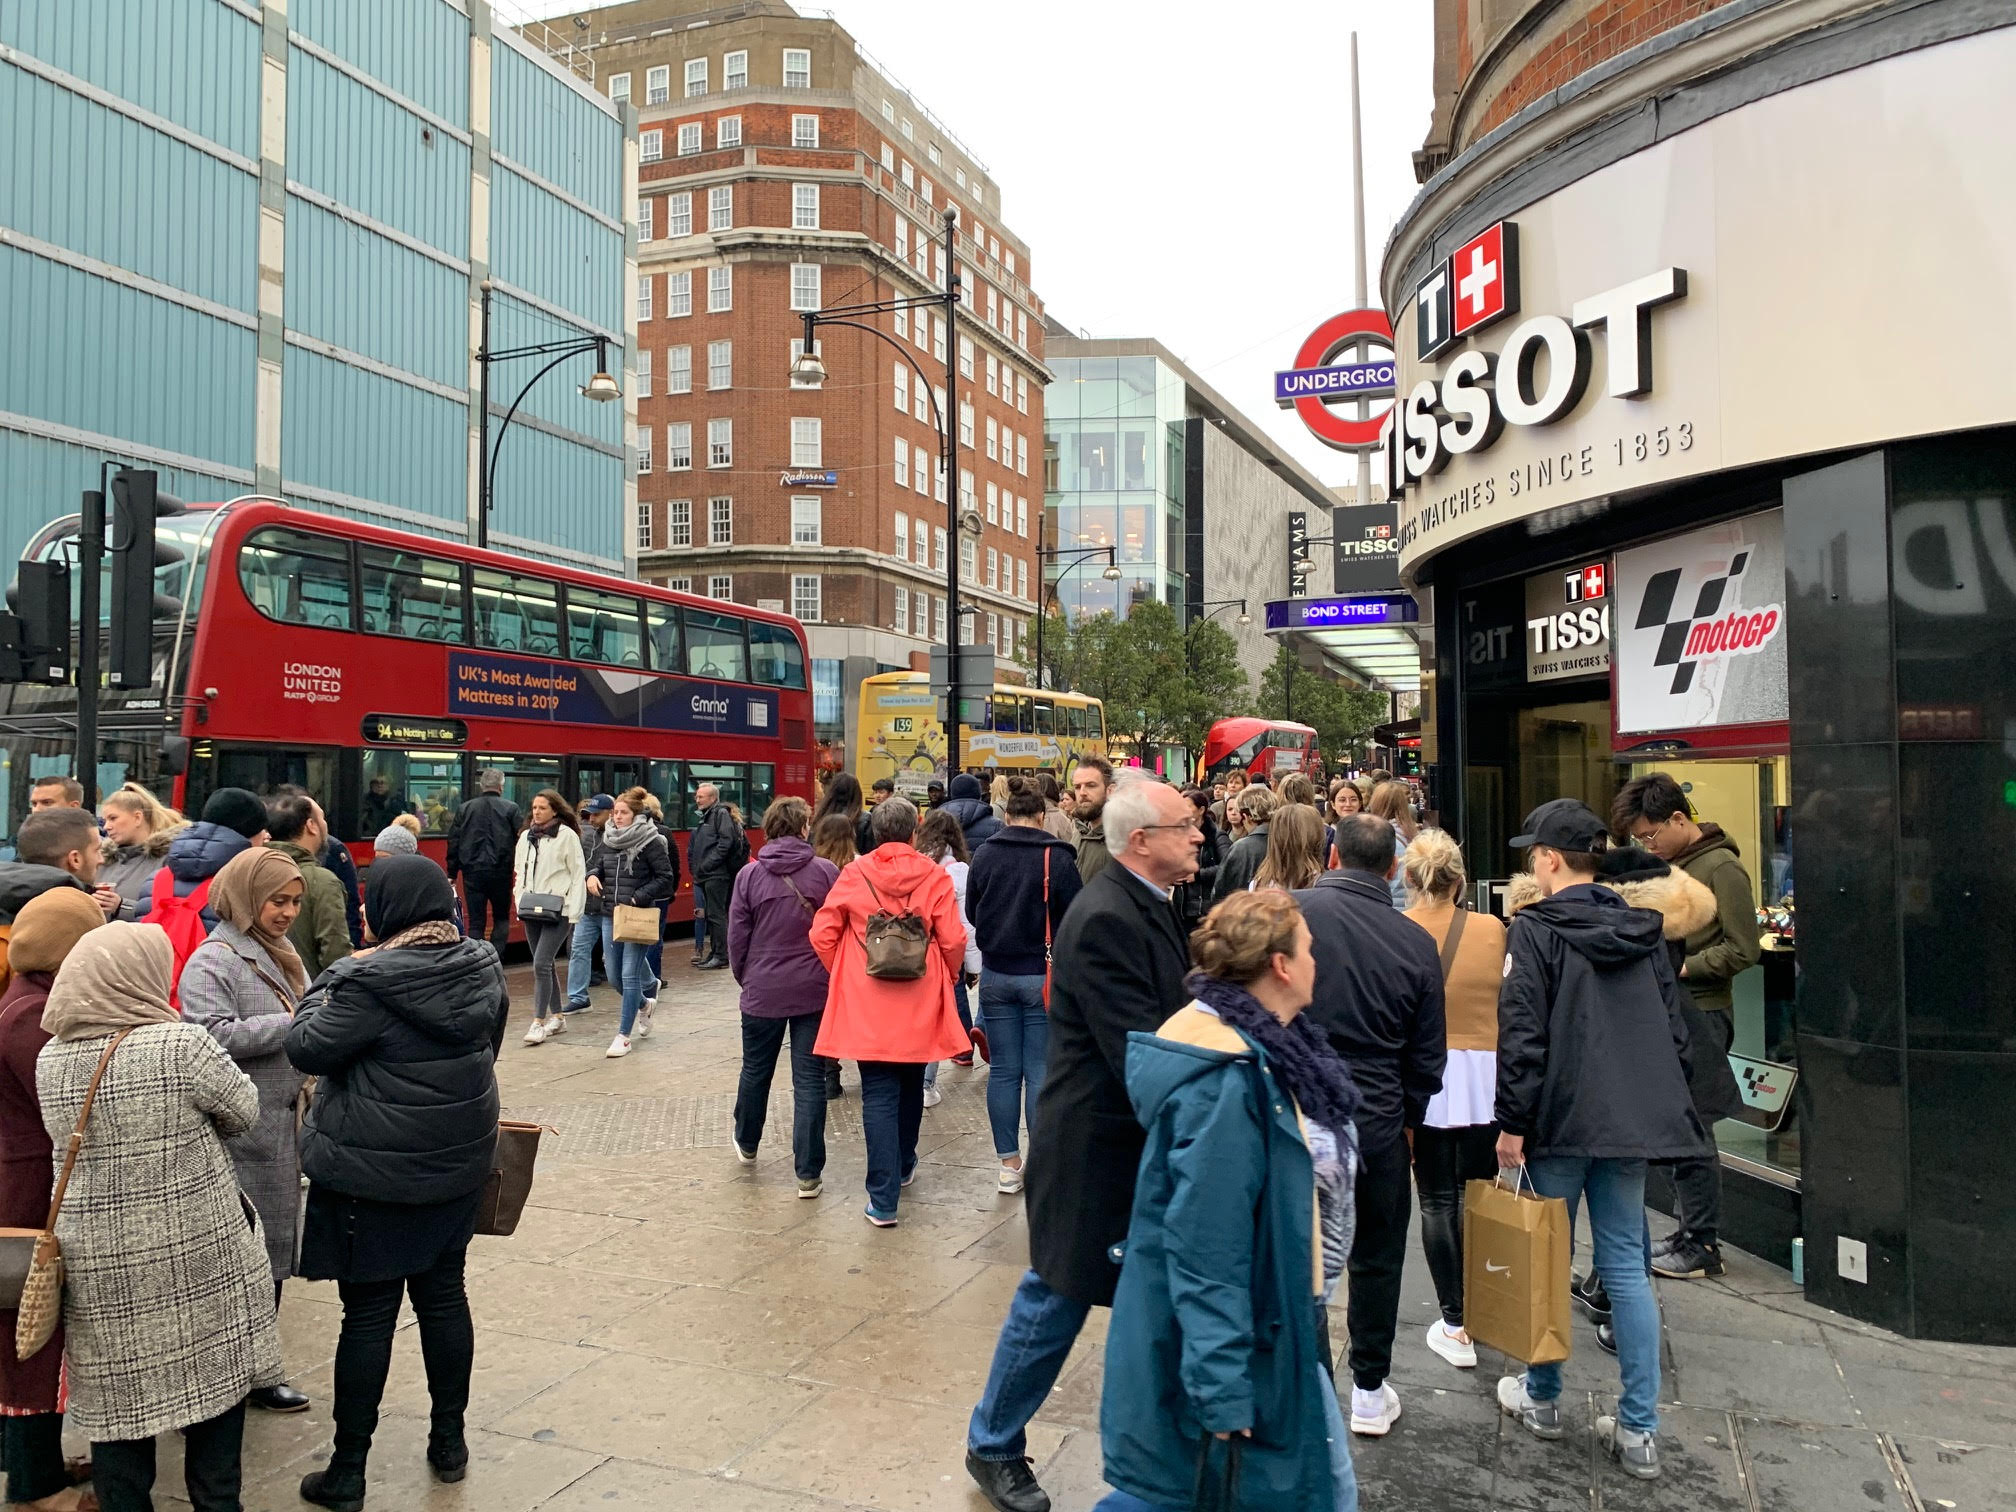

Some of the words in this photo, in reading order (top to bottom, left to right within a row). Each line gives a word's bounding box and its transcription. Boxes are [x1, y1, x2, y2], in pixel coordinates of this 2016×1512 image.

[1284, 366, 1396, 392] UNDERGRO
[1379, 267, 1676, 501] TISSOT
[780, 469, 825, 486] Radisson
[1421, 477, 1495, 532] WATCHES
[1509, 445, 1594, 497] SINCE
[1613, 420, 1694, 466] 1853
[1340, 538, 1398, 555] TISSO
[1302, 606, 1339, 618] BOND
[1342, 603, 1388, 616] STREET
[284, 662, 341, 679] LONDON
[1533, 662, 1558, 676] SWISS
[1561, 655, 1600, 671] WATCHES
[1603, 653, 1610, 665] S
[284, 677, 341, 693] UNITED
[458, 665, 488, 682] UK's
[491, 669, 521, 687] Most
[524, 673, 577, 692] Awarded
[284, 691, 306, 699] RATP
[316, 694, 341, 702] GROUP
[458, 686, 514, 706] Mattress
[517, 692, 529, 708] in
[532, 694, 559, 710] 2019
[691, 695, 727, 714] Emma
[377, 723, 392, 739] 94
[393, 728, 402, 737] via
[403, 727, 426, 741] Notting
[896, 719, 912, 731] 139
[999, 742, 1024, 753] WONDERFUL
[1025, 741, 1039, 752] WORLD
[1230, 757, 1241, 766] 390
